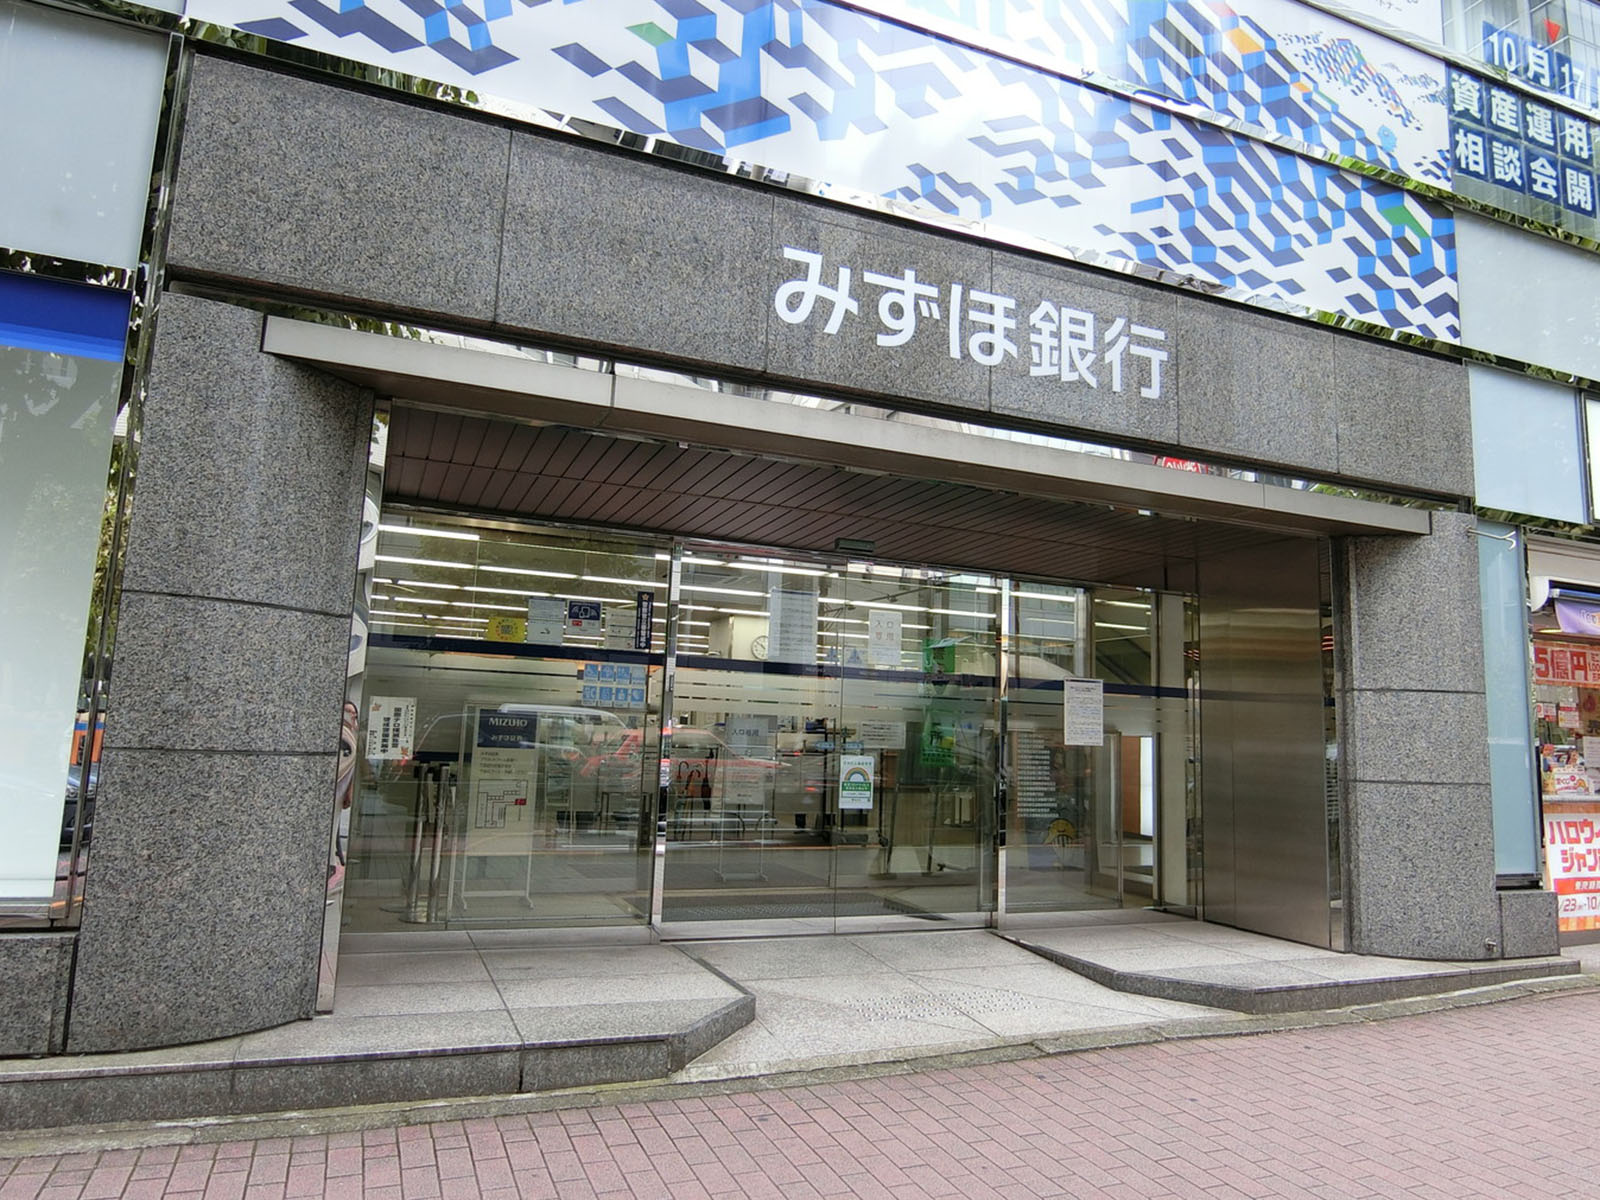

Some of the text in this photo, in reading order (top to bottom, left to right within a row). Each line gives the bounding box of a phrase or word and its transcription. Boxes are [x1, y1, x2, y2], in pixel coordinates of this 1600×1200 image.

[1488, 32, 1600, 107] 10月17
[1452, 73, 1590, 159] 資産運用
[1455, 129, 1592, 211] 相談会開
[774, 246, 1169, 399] みずほ銀行
[875, 619, 894, 629] 入口
[1534, 647, 1588, 681] 5億円
[1561, 848, 1600, 873] ジャン
